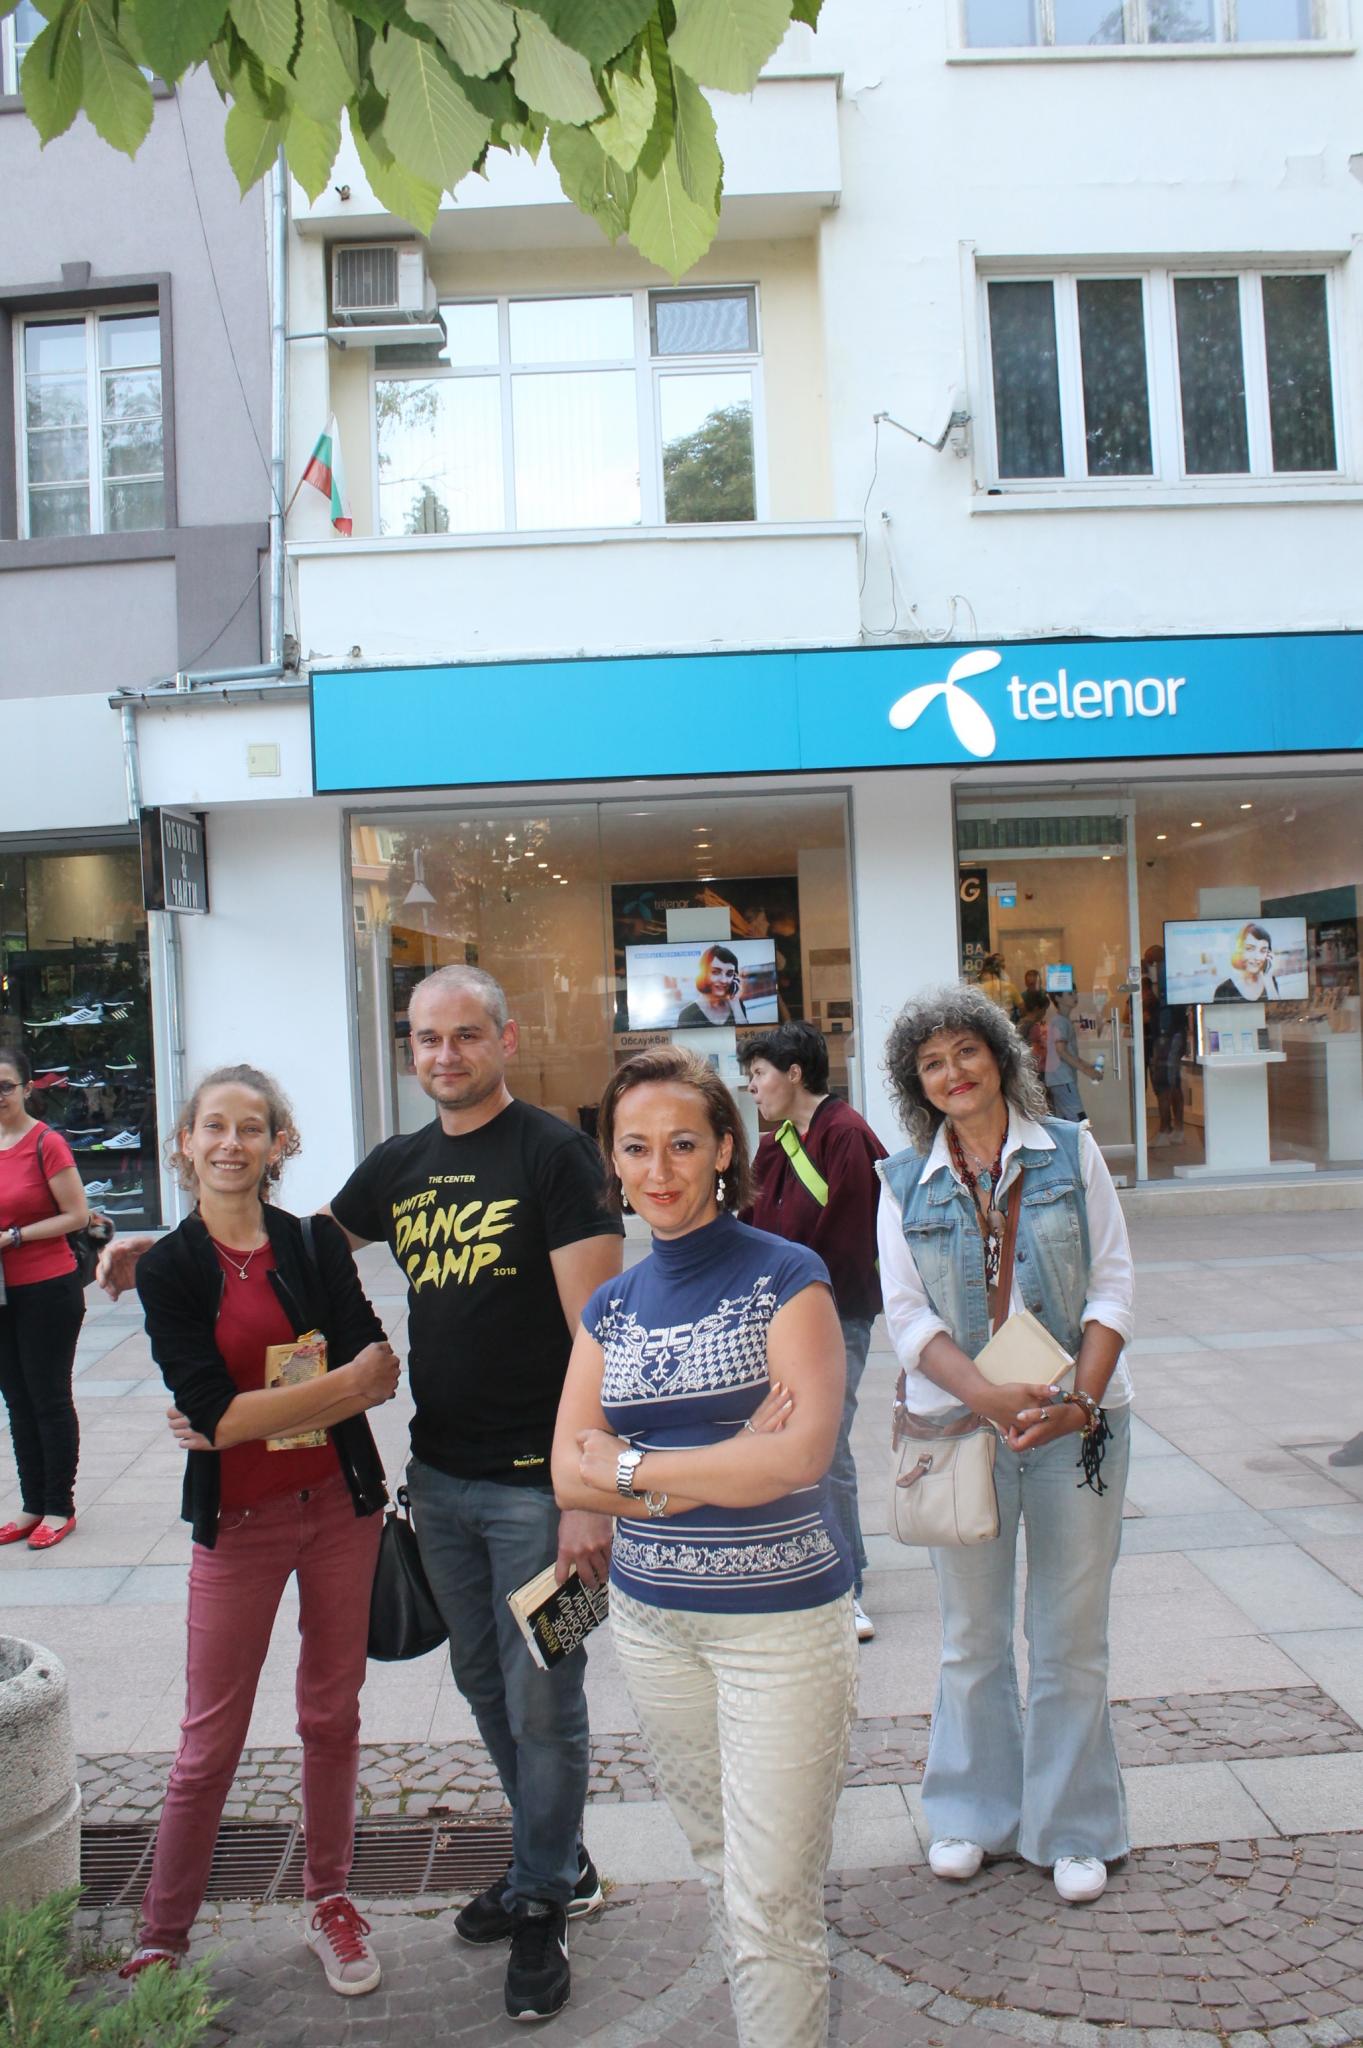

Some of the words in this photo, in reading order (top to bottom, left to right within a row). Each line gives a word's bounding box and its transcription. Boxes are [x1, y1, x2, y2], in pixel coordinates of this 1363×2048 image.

[1006, 668, 1186, 721] telenor
[165, 820, 198, 854] ОБУВКИ
[428, 1176, 442, 1184] THE
[443, 1174, 476, 1184] CENTER
[392, 1189, 437, 1219] WINTER
[395, 1199, 520, 1259] DANCE
[406, 1242, 502, 1294] CAMP
[493, 1267, 517, 1276] 2018
[557, 1591, 585, 1645] ГРОБНИЦИ
[572, 1590, 594, 1626] УЧЕНИ
[552, 1615, 576, 1655] БОГОВЕ
